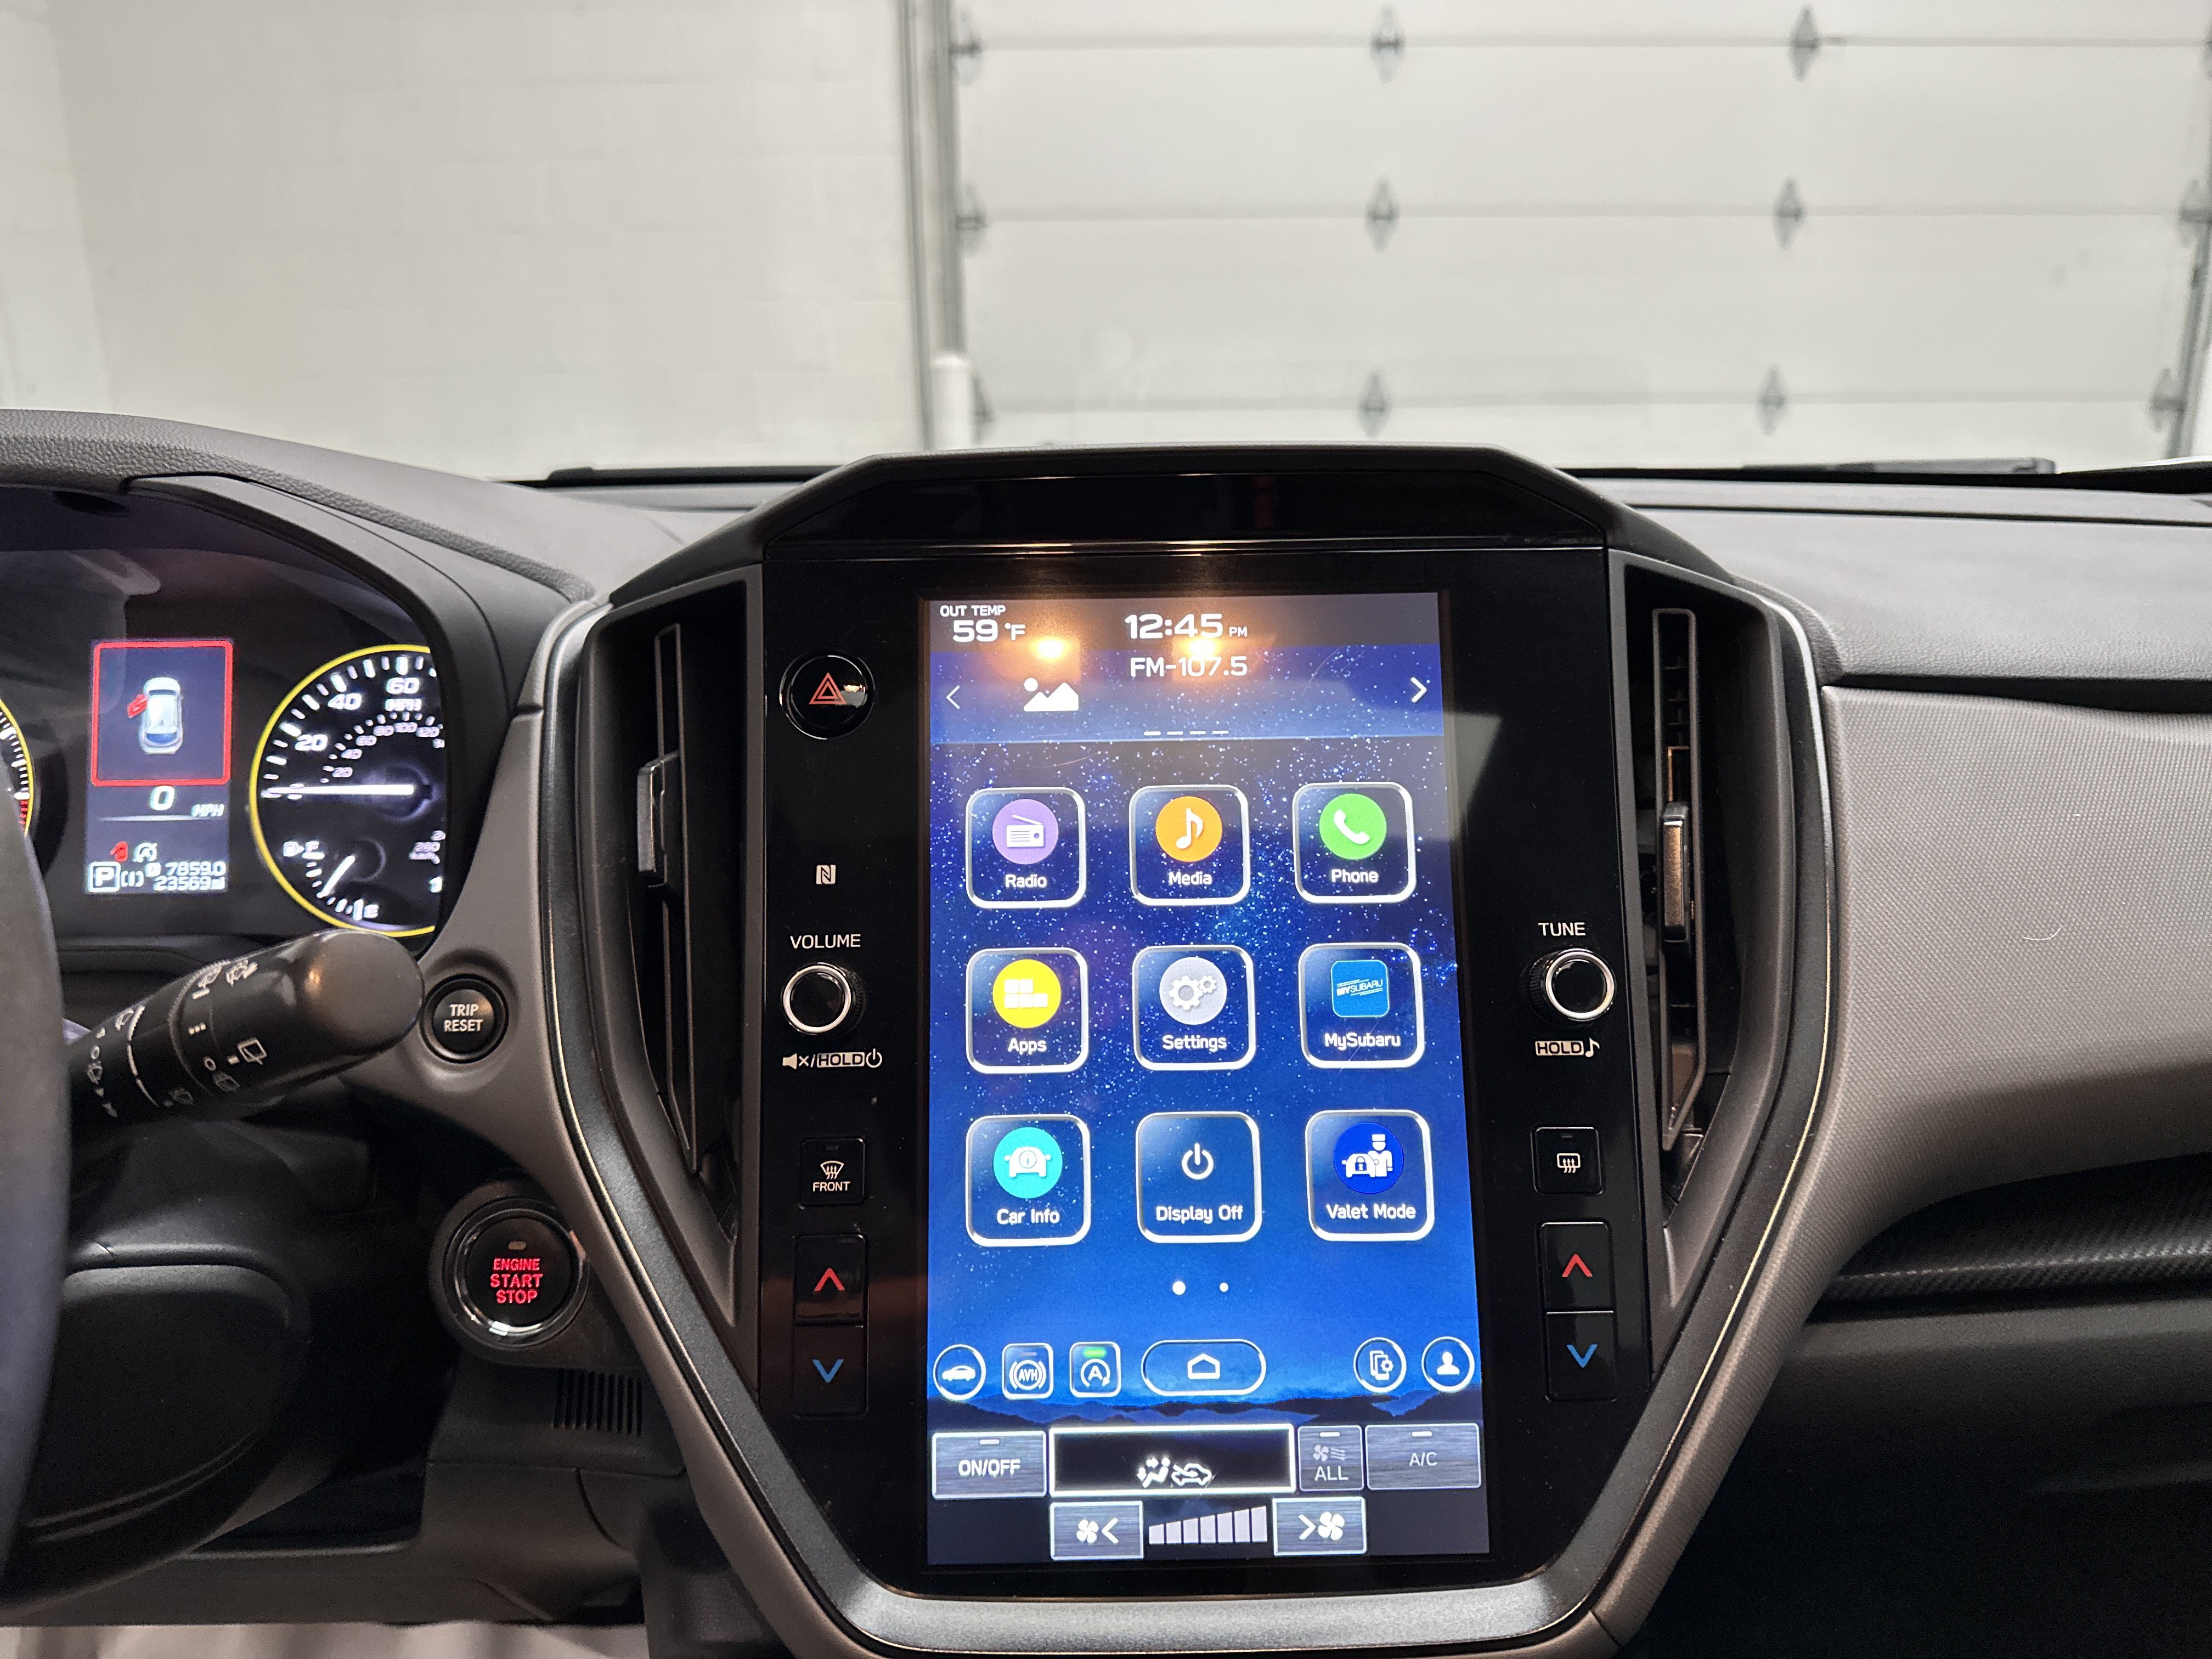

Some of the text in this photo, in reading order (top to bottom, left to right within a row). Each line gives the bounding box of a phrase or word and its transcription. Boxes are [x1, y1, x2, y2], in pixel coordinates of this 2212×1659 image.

[940, 605, 1006, 617] OUT TEMP
[953, 619, 998, 642] 59
[1125, 613, 1248, 639] 12:45 PM
[1130, 656, 1248, 678] FM-107.5
[386, 677, 421, 695] 60
[328, 693, 362, 710] 40
[385, 698, 422, 712] MPH
[294, 734, 329, 752] 20
[150, 786, 175, 811] 0
[192, 804, 224, 817] MPH
[165, 862, 227, 876] 7859.0
[1331, 869, 1379, 883] Phone
[95, 867, 115, 887] P
[1005, 873, 1047, 888] Radio
[1169, 871, 1212, 885] Media
[365, 905, 379, 918] E
[1538, 922, 1586, 936] TUNE
[790, 934, 861, 949] VOLUME
[449, 1003, 479, 1017] TRIP
[444, 1019, 483, 1032] RESET
[1007, 1037, 1047, 1055] Apps
[1162, 1034, 1227, 1052] Settings
[1324, 1032, 1401, 1051] MySubaru
[1537, 1042, 1582, 1054] HOLD
[813, 1181, 850, 1192] FRONT
[997, 1209, 1060, 1224] Car Info
[1155, 1205, 1243, 1222] Display Off
[1326, 1204, 1416, 1218] Valet Mode
[493, 1258, 540, 1271] ENGINE
[490, 1273, 543, 1288] START
[496, 1289, 538, 1304] STOP
[1018, 1368, 1038, 1381] AVH
[1409, 1452, 1438, 1466] A/C
[958, 1459, 1021, 1478] ON/OFF
[1314, 1465, 1349, 1481] ALL
